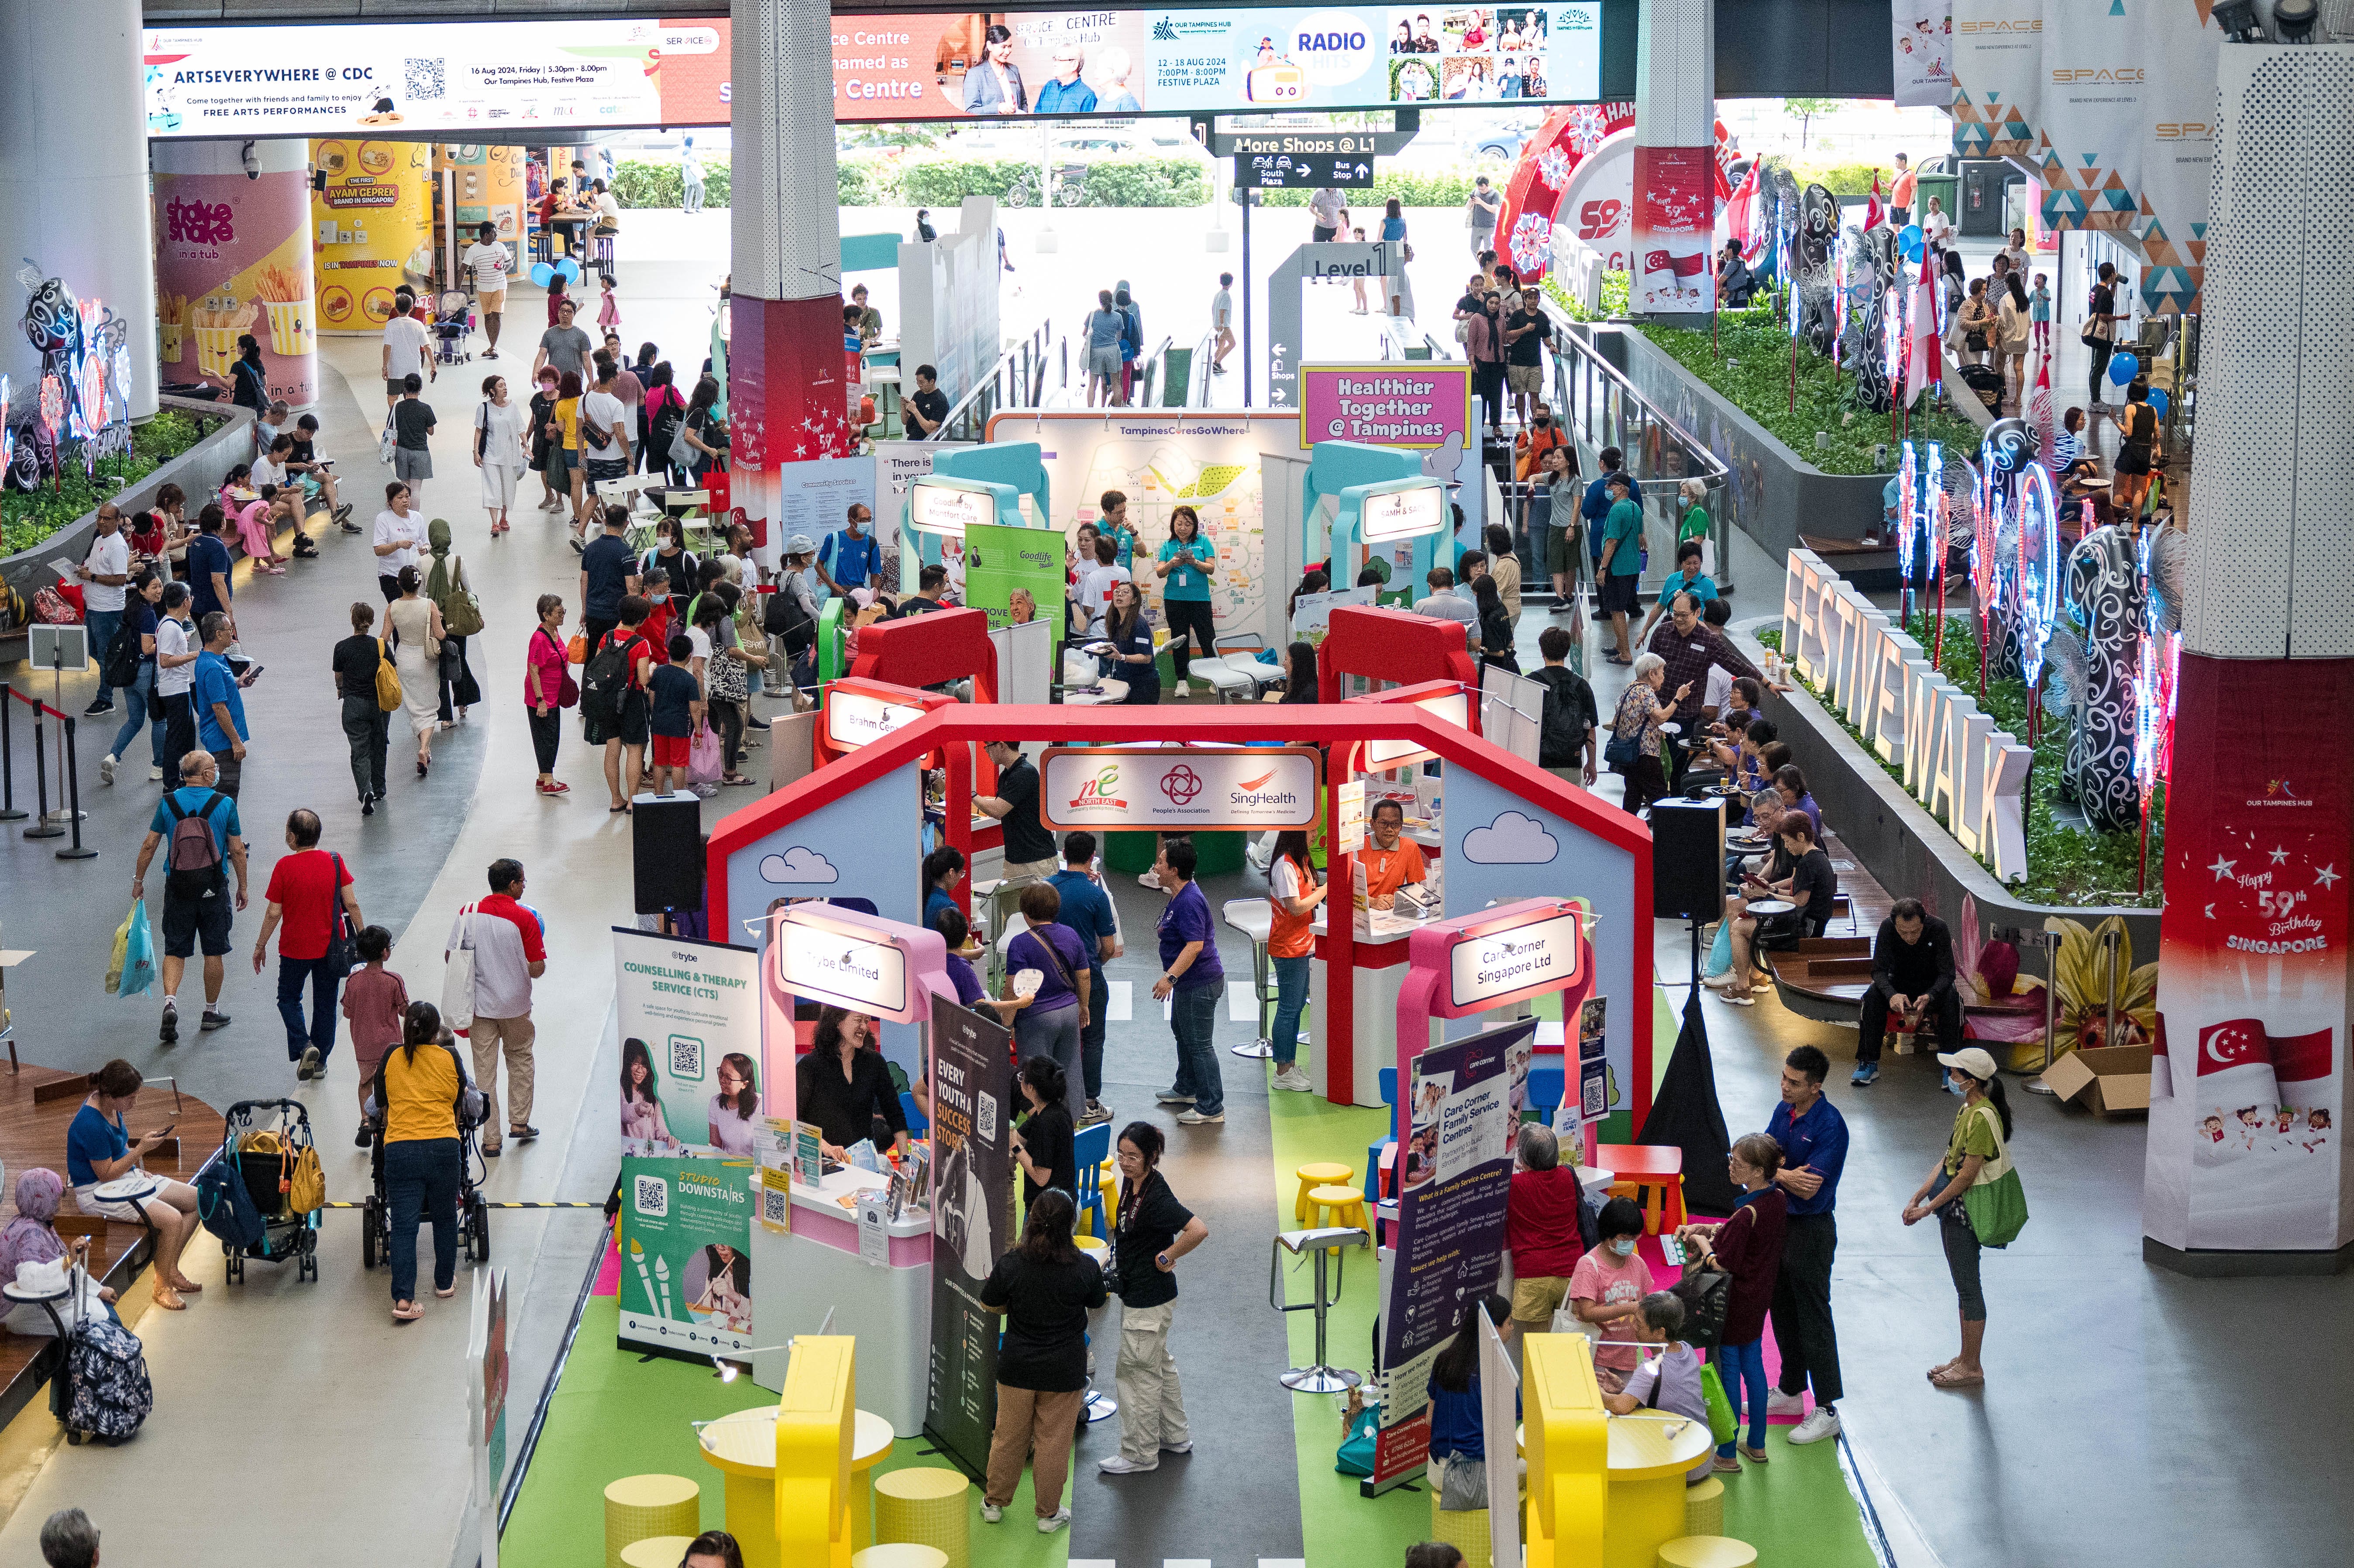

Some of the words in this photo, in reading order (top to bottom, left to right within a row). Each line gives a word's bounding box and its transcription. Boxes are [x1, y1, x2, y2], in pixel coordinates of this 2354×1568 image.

[1067, 13, 1117, 29] CENTRE
[854, 32, 910, 45] Centre
[1081, 34, 1100, 43] Hub
[1298, 33, 1366, 51] RADIO
[891, 58, 908, 69] as
[1312, 53, 1351, 69] HITS
[175, 68, 319, 83] ARTSEVERYWHERE
[326, 69, 336, 80] @
[343, 68, 372, 80] CDC
[846, 79, 923, 100] Centre
[211, 97, 243, 106] together
[264, 107, 347, 115] PERFORMANCES
[1236, 138, 1279, 152] More
[1283, 138, 1335, 152] Shops
[1339, 138, 1355, 152] @
[1359, 137, 1375, 151] L1
[1333, 171, 1352, 180] Stop
[330, 188, 357, 198] AYAM
[359, 187, 396, 197] GEPREK
[1656, 197, 1671, 205] Happy
[1669, 215, 1693, 225] Birthday
[1652, 224, 1695, 233] SINGAPORE
[179, 248, 188, 259] in
[199, 248, 220, 259] tub
[1315, 260, 1372, 276] Level
[1372, 242, 1387, 276] 1
[340, 260, 378, 268] TAMPINES
[1271, 372, 1295, 380] Shops
[271, 384, 282, 396] in
[287, 386, 295, 395] a
[1337, 378, 1435, 396] Healthier
[1339, 399, 1433, 422] Together
[1328, 418, 1346, 436] @
[1350, 419, 1444, 440] Tampines
[735, 456, 762, 471] SINGAPORE
[891, 459, 920, 467] There
[802, 480, 832, 488] Community
[964, 502, 973, 511] by
[1380, 507, 1401, 519] SAMH
[961, 513, 977, 522] Care
[1020, 550, 1052, 562] Goodlife
[850, 715, 877, 729] Brahm
[1780, 549, 1906, 765] FESTIVE
[1903, 659, 2028, 884] WALK
[1230, 791, 1296, 807] SingHealth
[2237, 871, 2273, 890] Happy
[2258, 890, 2307, 918] 59th
[2269, 914, 2322, 936] Birthday
[1483, 950, 1507, 964] Care
[1511, 939, 1545, 957] Corner
[2227, 935, 2328, 955] SINGAPORE
[678, 951, 698, 963] trybe
[623, 961, 691, 982] COUNSELLING
[692, 973, 701, 982] &
[702, 973, 747, 990] THERAPY
[839, 959, 878, 981] Limited
[1477, 960, 1531, 984] Singapore
[1535, 954, 1551, 969] Ltd
[652, 980, 692, 996] SERVICE
[693, 985, 719, 1001] (CTS)
[1480, 1056, 1495, 1066] corner
[938, 1058, 964, 1087] EVERY
[937, 1079, 966, 1111] YOUTH
[966, 1097, 972, 1115] A
[1444, 1104, 1464, 1119] Care
[1465, 1090, 1491, 1113] Corner
[937, 1102, 971, 1137] SUCCESS
[1443, 1111, 1468, 1131] Family
[1470, 1099, 1500, 1121] Service
[936, 1124, 962, 1152] STORY
[1442, 1124, 1473, 1145] Centres
[678, 1171, 720, 1186] STUDIO
[1419, 1193, 1433, 1202] What
[1444, 1182, 1460, 1193] Family
[1461, 1176, 1479, 1186] Service
[1480, 1168, 1502, 1180] Centre?
[678, 1181, 745, 1206] DOWNSTAIRS
[1411, 1261, 1427, 1273] Issues
[1436, 1253, 1447, 1263] help
[1448, 1248, 1460, 1259] with:
[1394, 1372, 1407, 1382] How
[1416, 1356, 1430, 1369] help?
[1397, 1424, 1411, 1434] Corner
